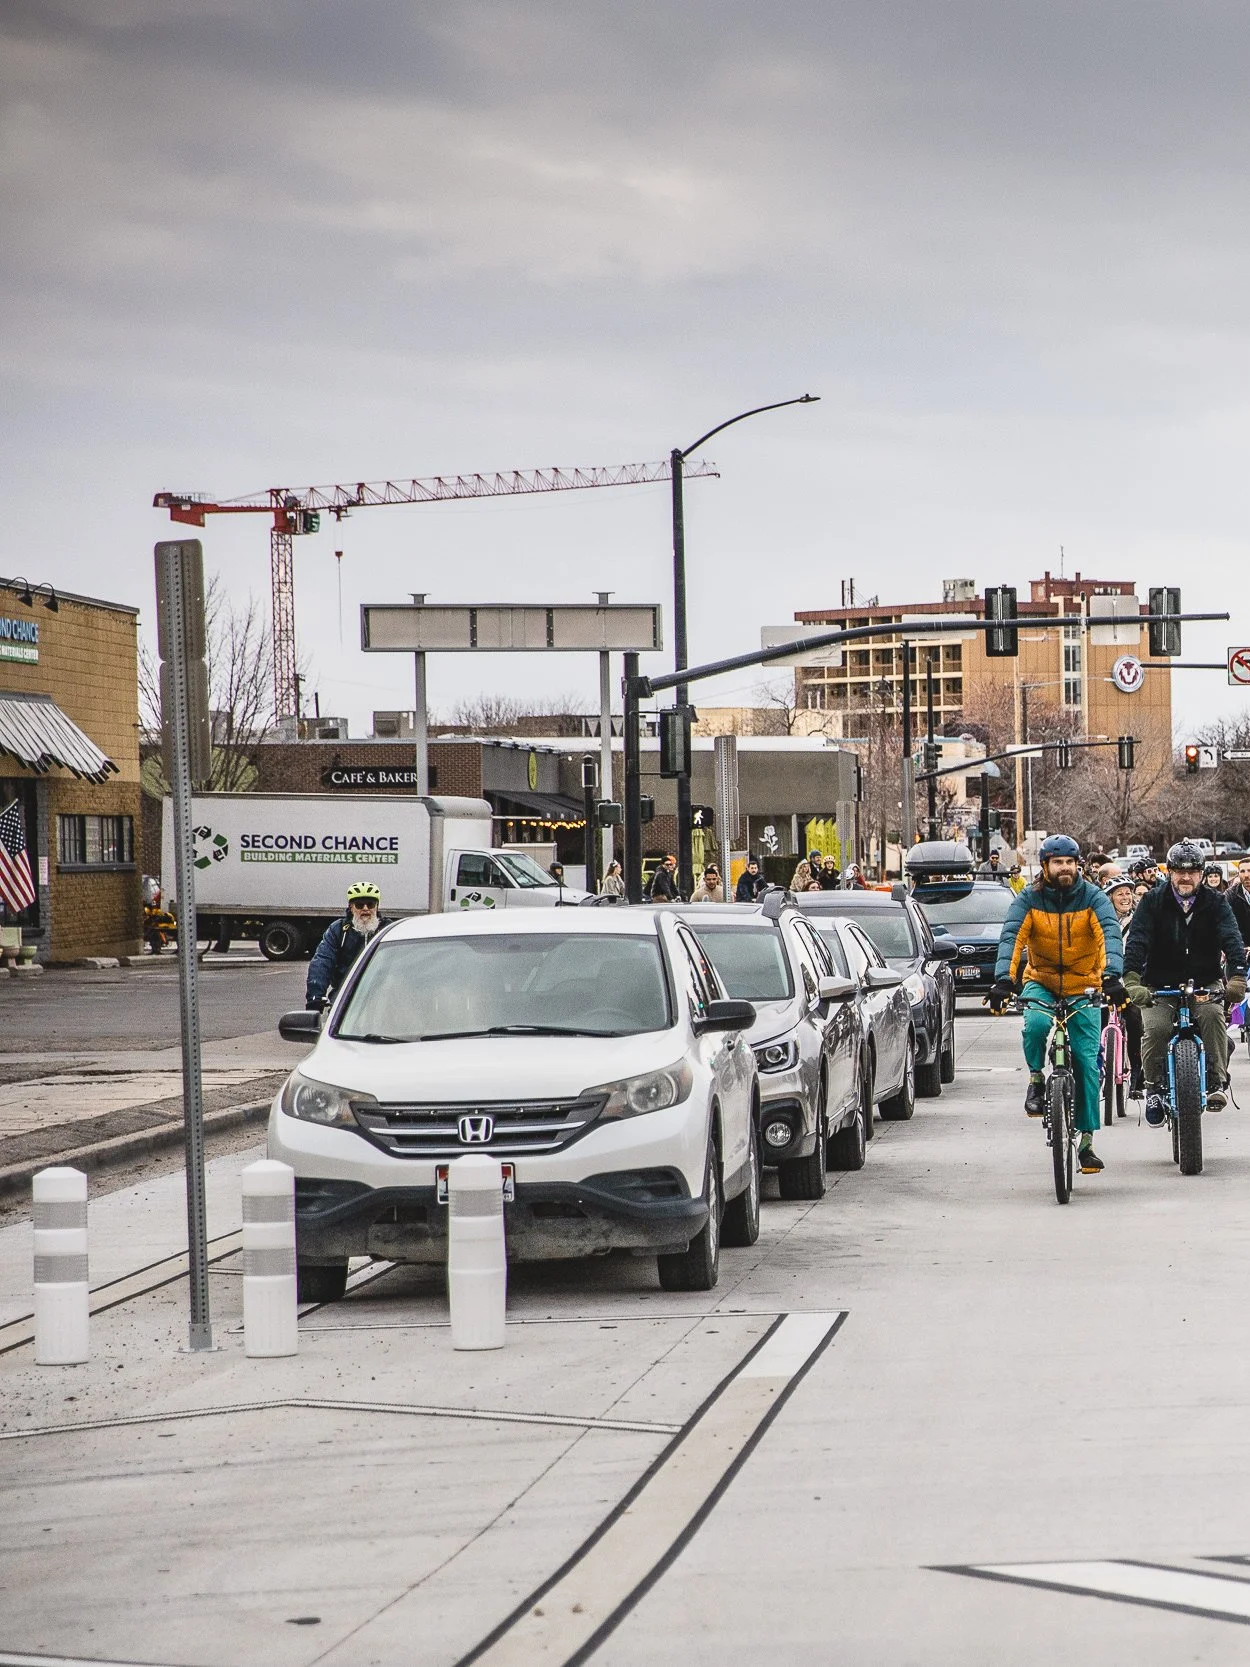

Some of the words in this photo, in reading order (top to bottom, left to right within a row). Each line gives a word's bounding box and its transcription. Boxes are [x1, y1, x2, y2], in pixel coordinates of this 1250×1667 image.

[379, 771, 418, 783] BAKER
[240, 834, 317, 850] SECOND
[321, 836, 399, 851] CHANCE
[243, 852, 293, 862] BUILDING
[295, 852, 353, 863] MATERIALS
[355, 853, 396, 863] CENTER
